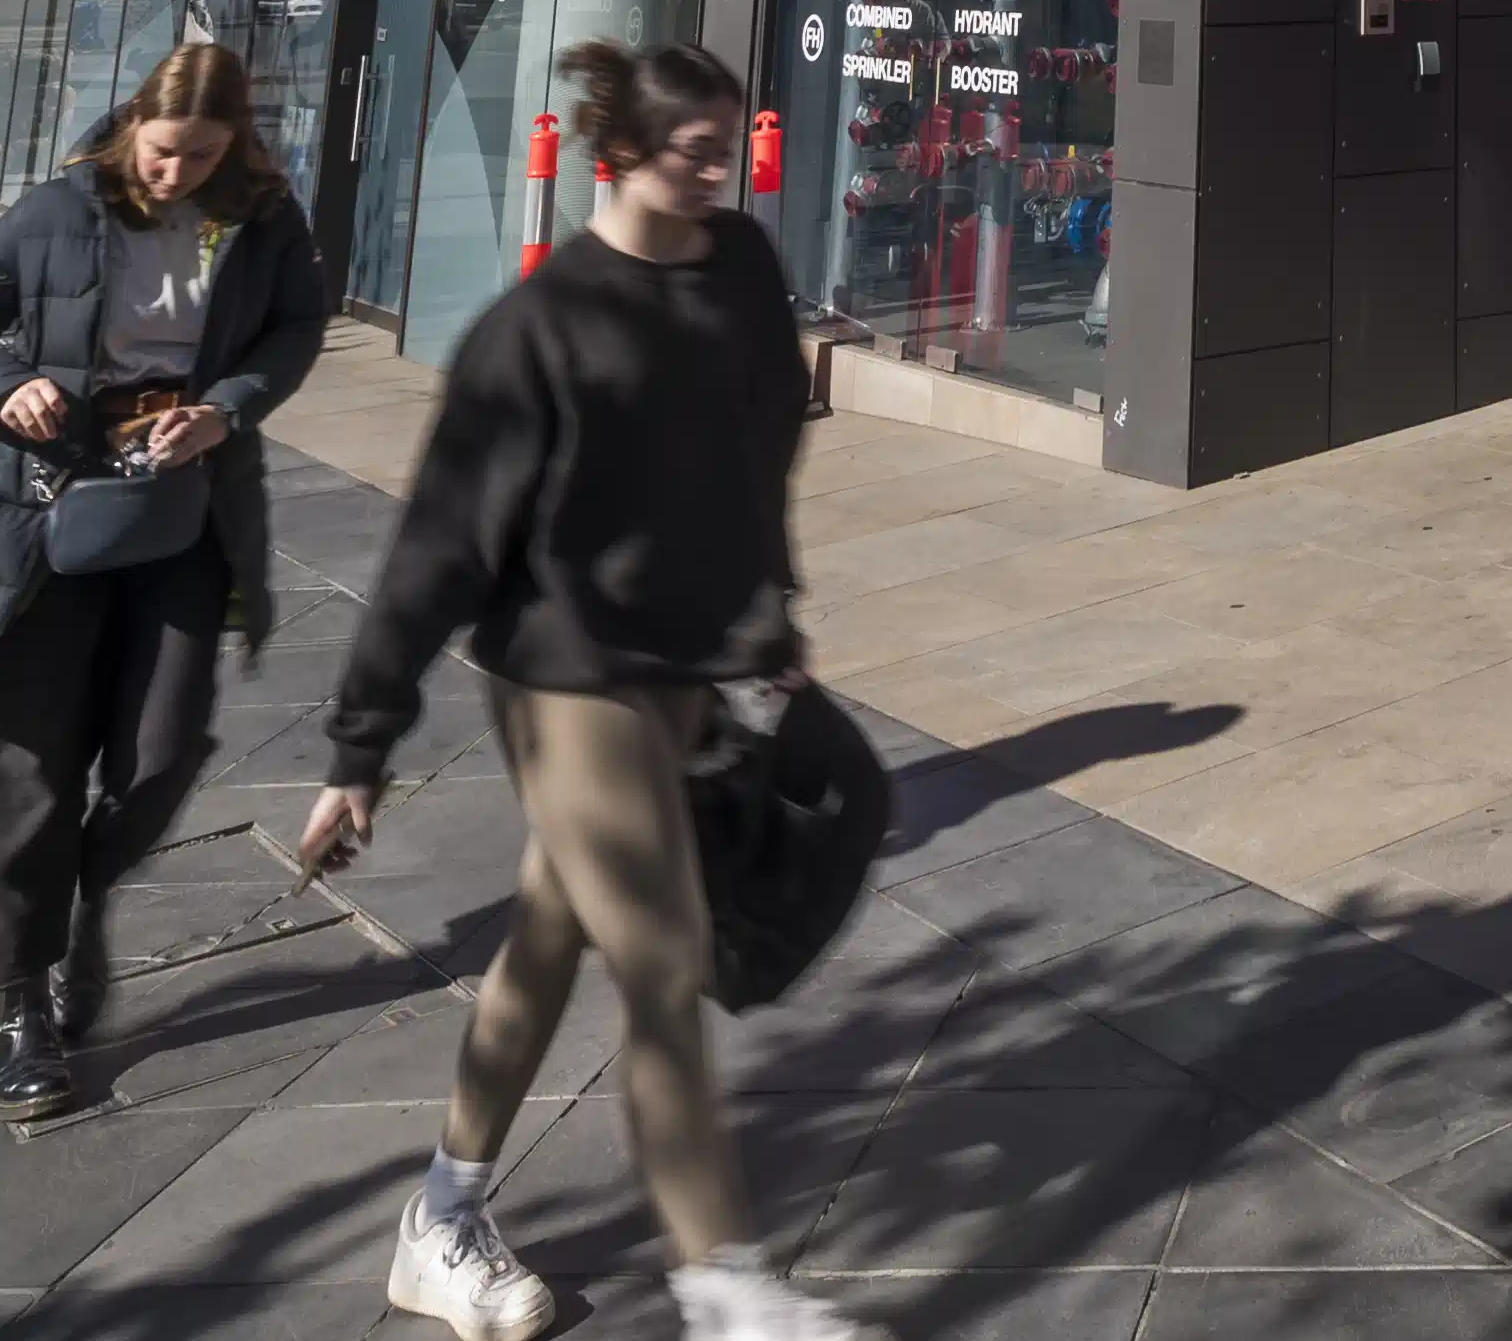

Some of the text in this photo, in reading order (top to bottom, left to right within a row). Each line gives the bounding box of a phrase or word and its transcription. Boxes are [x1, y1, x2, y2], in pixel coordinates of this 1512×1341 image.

[845, 3, 913, 30] COMBINED
[954, 9, 1023, 37] HYDRANT
[804, 26, 821, 49] FH
[842, 53, 912, 84] SPRINKLER
[951, 65, 1019, 95] BOOSTER
